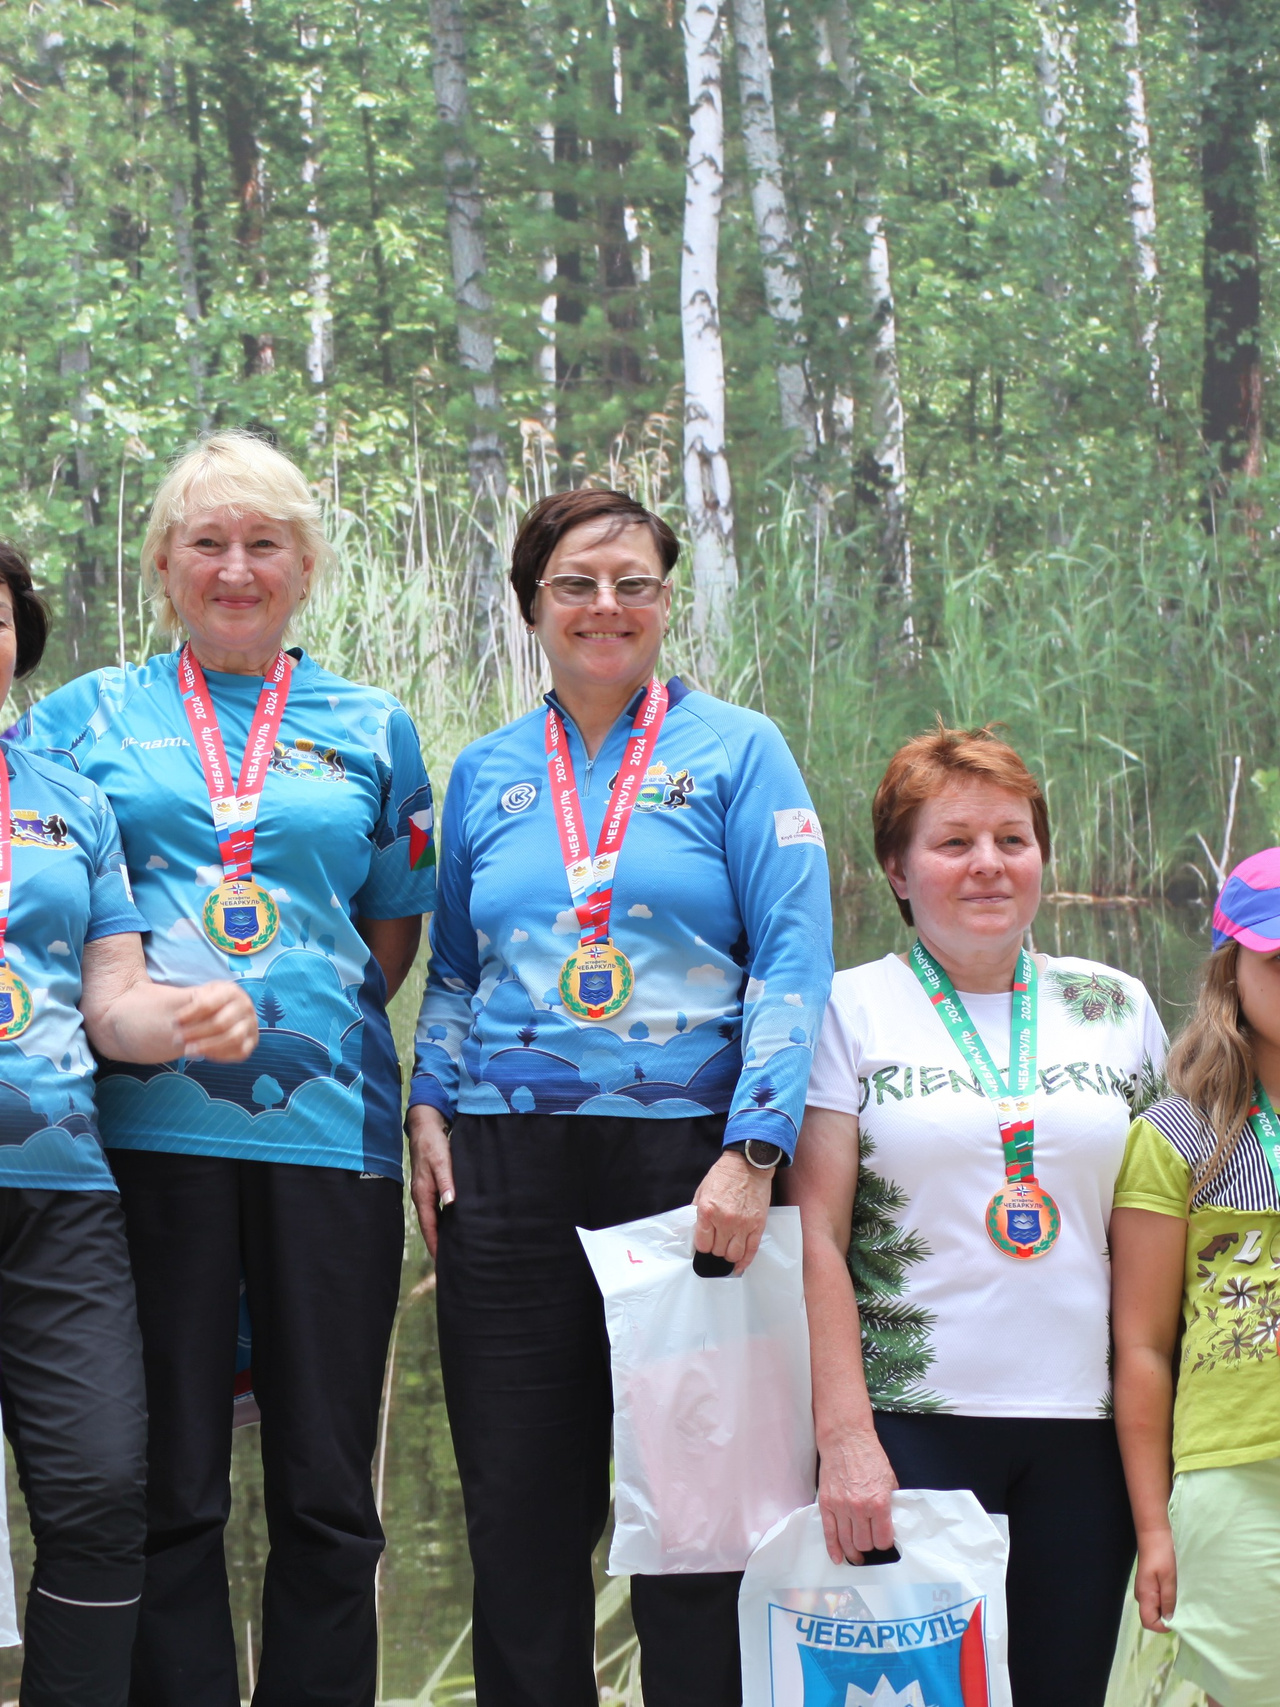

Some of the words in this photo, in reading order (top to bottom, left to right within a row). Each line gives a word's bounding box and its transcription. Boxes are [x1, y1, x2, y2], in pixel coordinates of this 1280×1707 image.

[191, 696, 207, 720] 2024
[245, 723, 270, 788] ЧЕБАРКУЛЬ
[264, 691, 280, 716] 2024
[200, 726, 226, 793] ЧЕБАРКУЛЬ
[554, 755, 567, 783] 2024
[605, 774, 636, 845] ЧЕБАРКУЛЬ
[630, 738, 647, 766] 2024
[560, 789, 580, 858] ЧЕБАРКУЛЬ
[576, 963, 616, 971] ЧЕБАРКУЛЬ
[941, 997, 963, 1024] 2024
[1021, 994, 1032, 1021] 2024
[960, 1029, 1000, 1092] ЧЕБАРКУЛЬ
[1017, 1027, 1032, 1092] ЧЕБАРКУЛЬ
[1257, 1111, 1276, 1138] 2024
[795, 1612, 969, 1649] ЧЕБАРКУЛЬ
